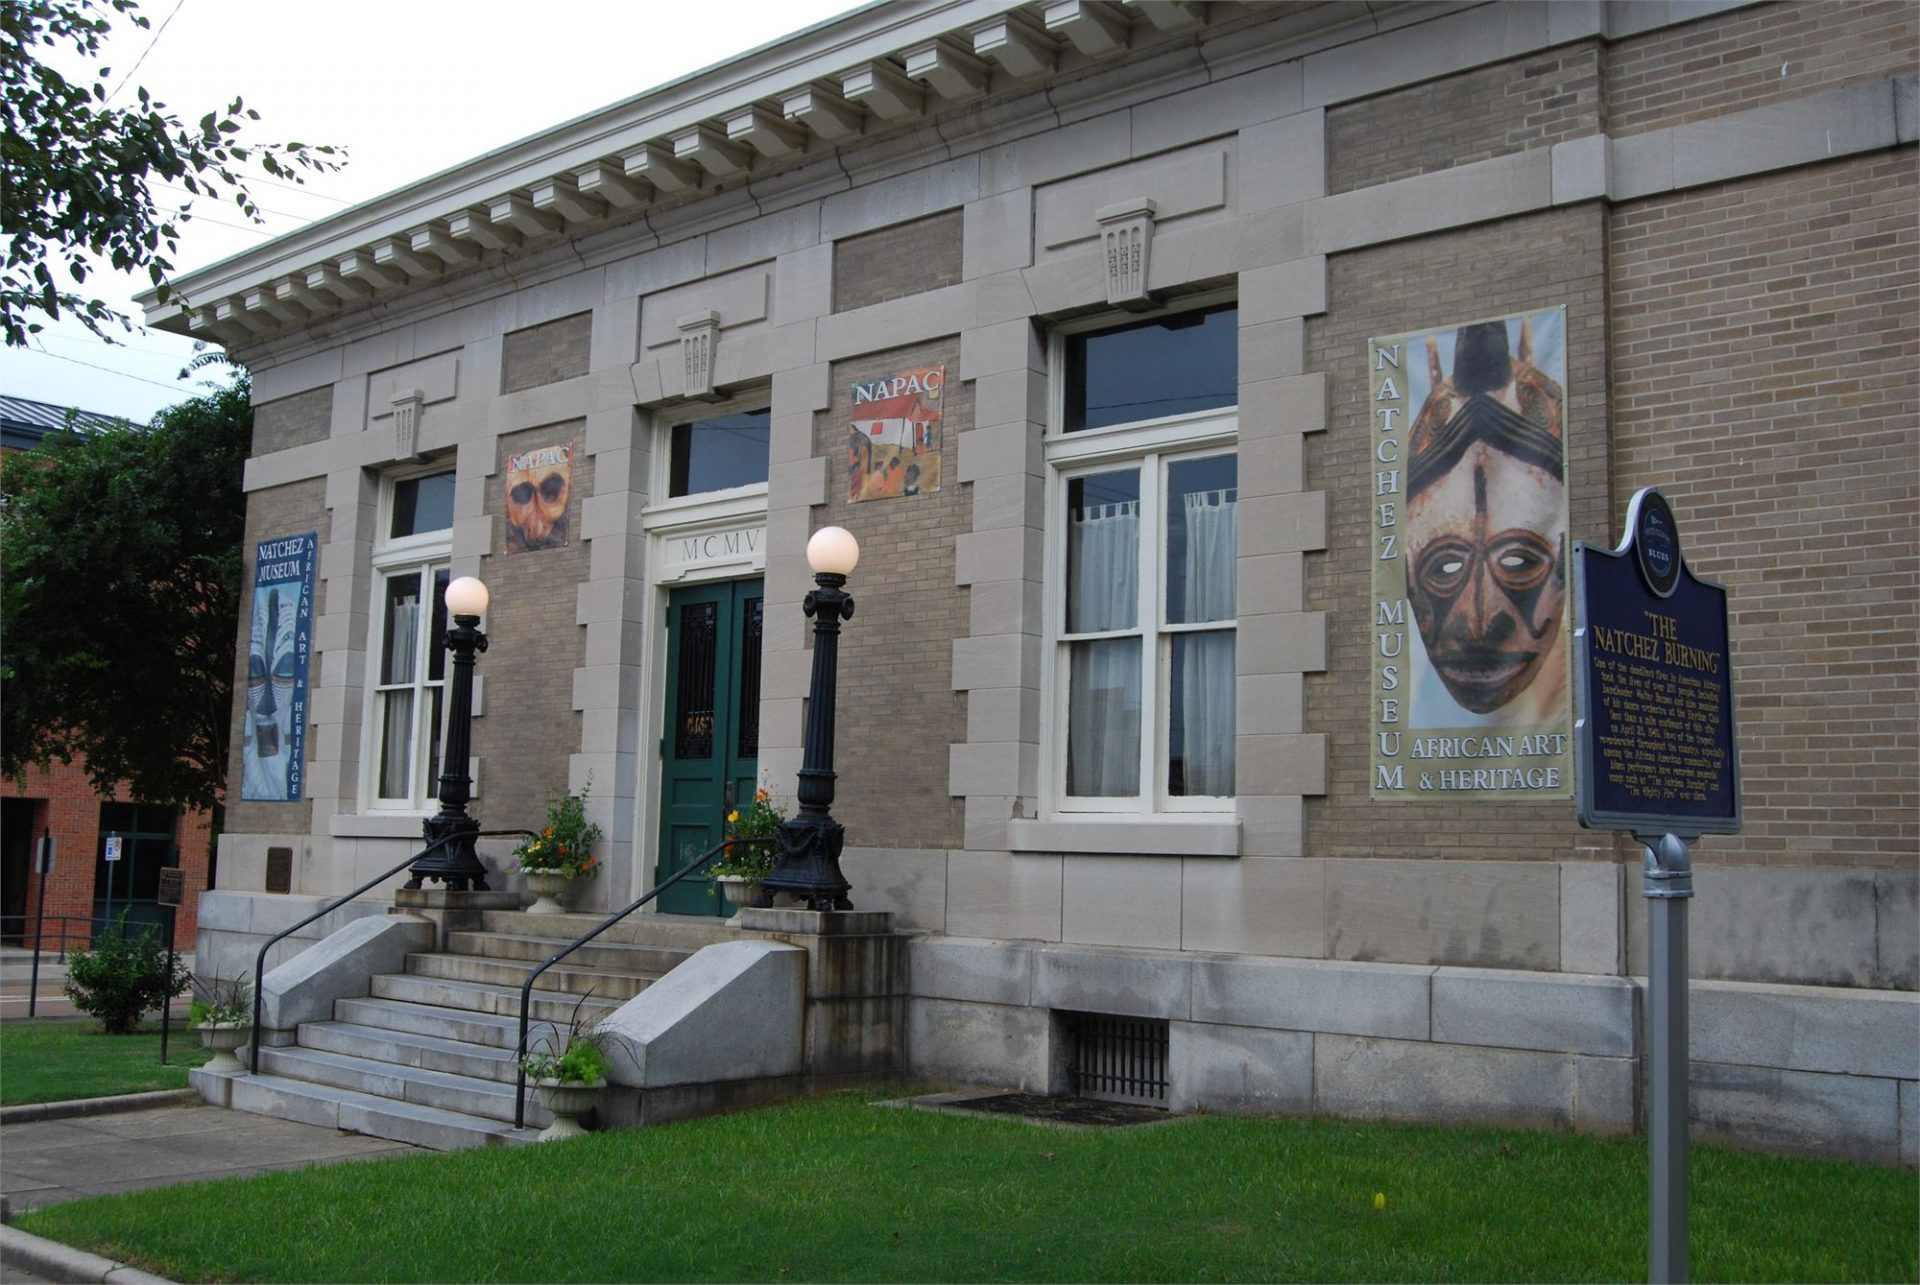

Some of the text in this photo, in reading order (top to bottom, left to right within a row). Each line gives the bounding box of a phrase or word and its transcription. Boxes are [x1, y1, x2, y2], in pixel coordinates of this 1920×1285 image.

[855, 371, 940, 405] NAPAC
[511, 447, 570, 473] NAPAC
[259, 538, 304, 561] NATCHEZ
[258, 559, 301, 583] MUSEUM
[300, 539, 314, 618] AFRICAN
[1376, 344, 1405, 791] NATCHEZ MUSEUM
[298, 631, 307, 665] ART
[1593, 625, 1660, 663] NATCHEZ
[291, 702, 303, 795] HERITAGE
[1410, 733, 1567, 760] AFRICAN ART
[1419, 766, 1560, 790] & HERITAGE
